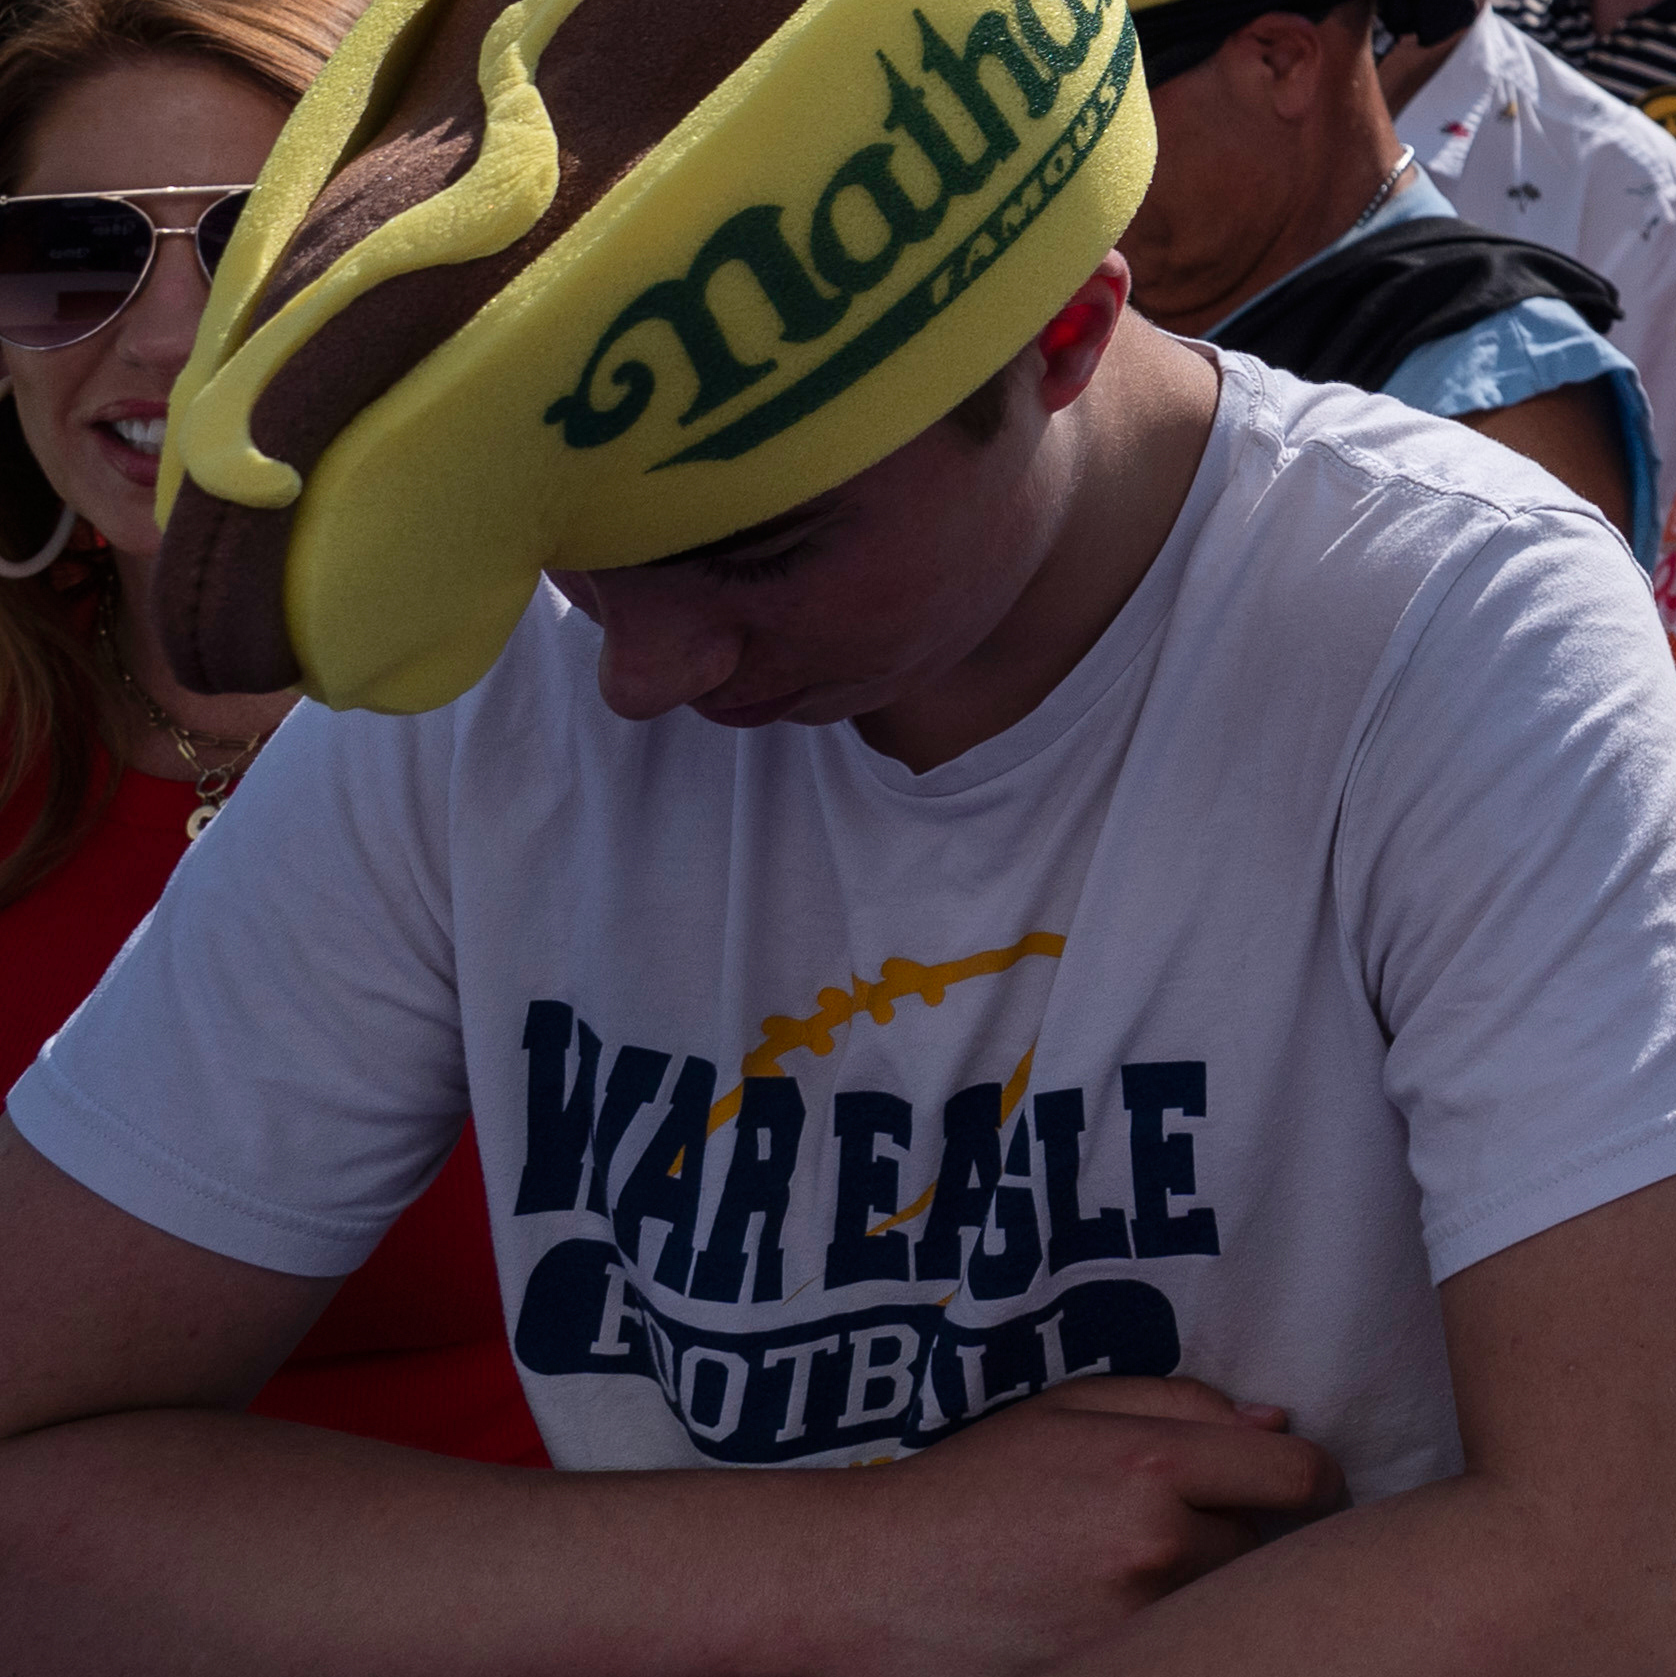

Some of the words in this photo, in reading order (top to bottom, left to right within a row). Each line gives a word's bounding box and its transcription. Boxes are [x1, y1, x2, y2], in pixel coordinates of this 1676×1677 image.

[931, 83, 1117, 305] FAMOUS
[514, 1001, 806, 1304] WAR
[824, 1060, 1222, 1301] EAGLE
